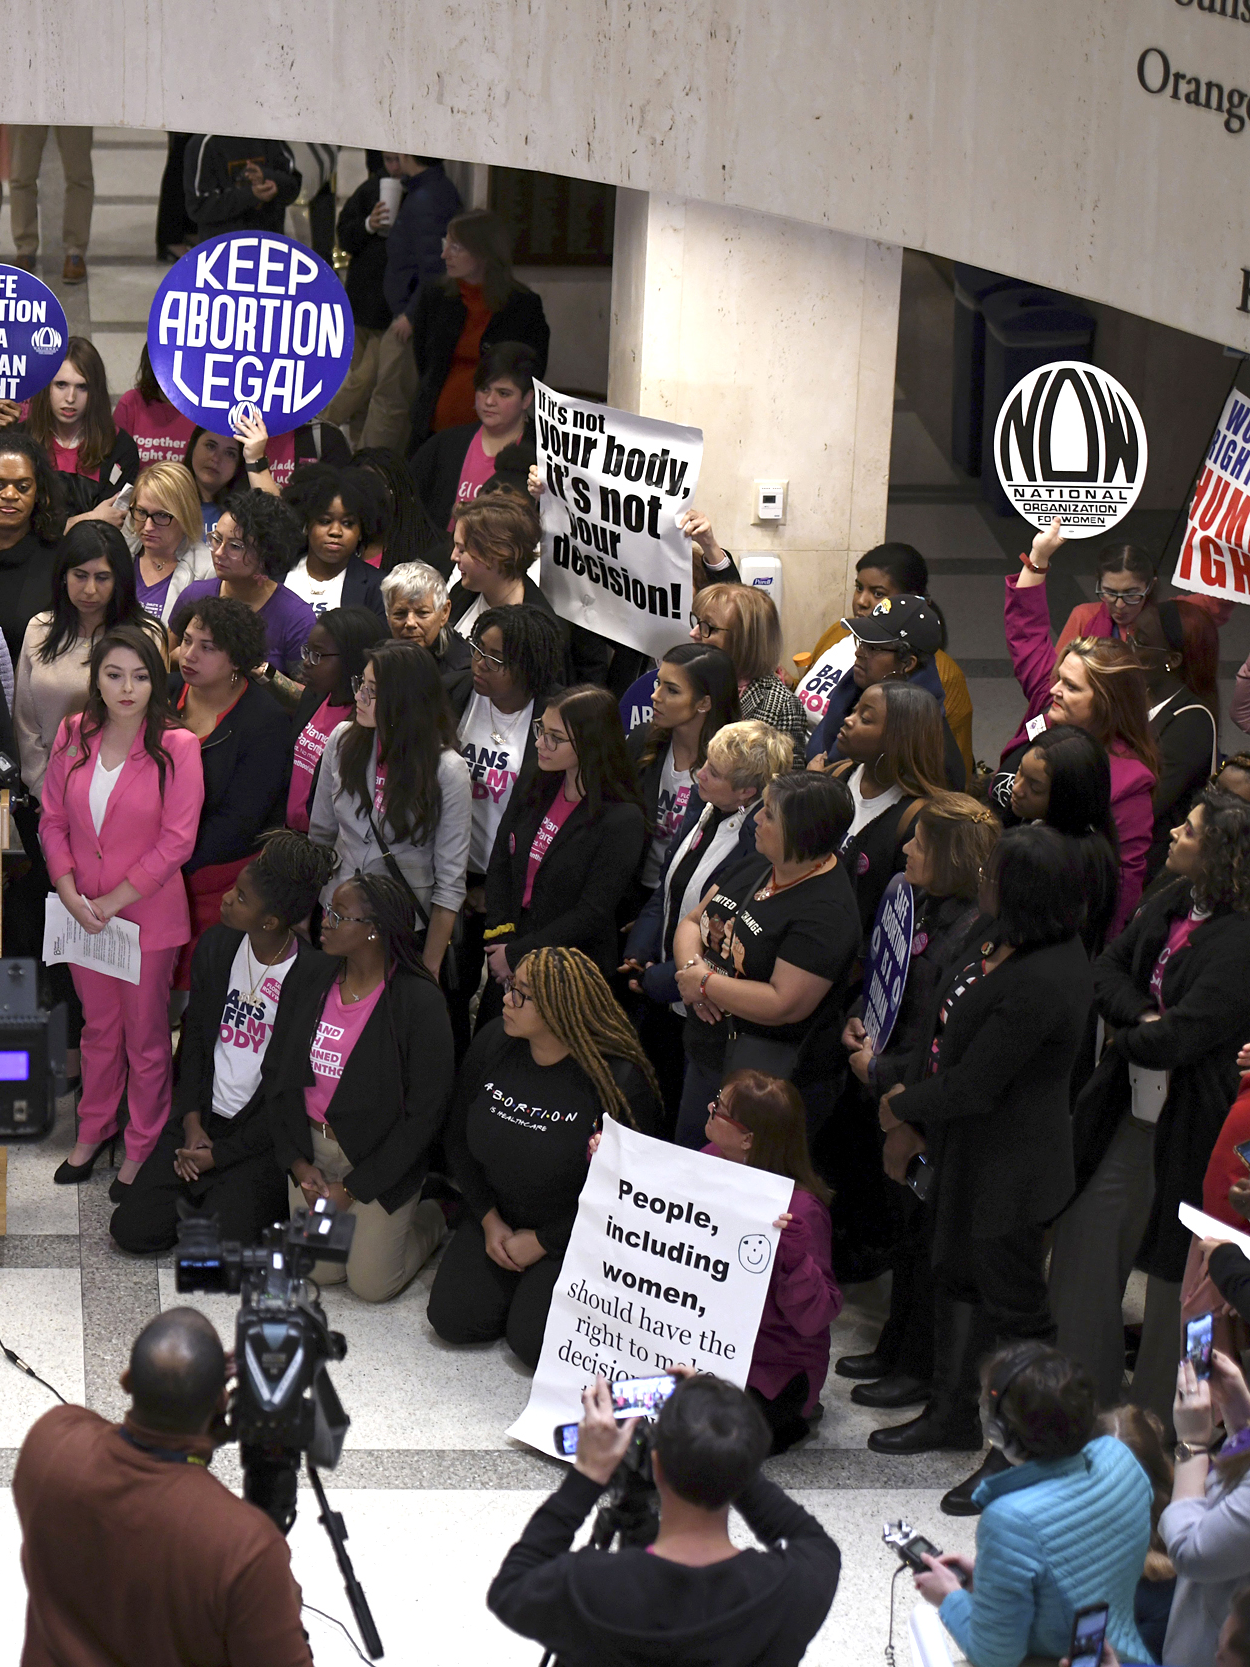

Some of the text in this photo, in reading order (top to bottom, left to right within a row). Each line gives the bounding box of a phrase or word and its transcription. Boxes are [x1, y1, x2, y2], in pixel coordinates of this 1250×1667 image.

[1137, 48, 1250, 133] Orang
[195, 238, 319, 295] KEEP
[159, 291, 344, 358] ABORTION
[172, 350, 322, 413] LEGAL
[538, 389, 605, 434] If it's not
[1000, 368, 1139, 483] NOW
[133, 435, 186, 448] Together
[166, 451, 184, 462] for
[538, 415, 690, 500] your body,
[546, 454, 662, 540] it's not
[1013, 488, 1127, 500] NATIONAL
[1023, 503, 1117, 513] ORGANIZATION
[1061, 516, 1105, 524] WOMEN
[565, 505, 621, 560] your
[553, 532, 682, 620] decision!
[805, 678, 833, 699] OF
[497, 1110, 547, 1132] HEALTHCARE
[618, 1178, 719, 1237] People,
[605, 1215, 730, 1283] including
[602, 1260, 707, 1318] women,
[567, 1279, 736, 1360] should have the
[575, 1316, 623, 1352] right
[629, 1339, 648, 1362] to
